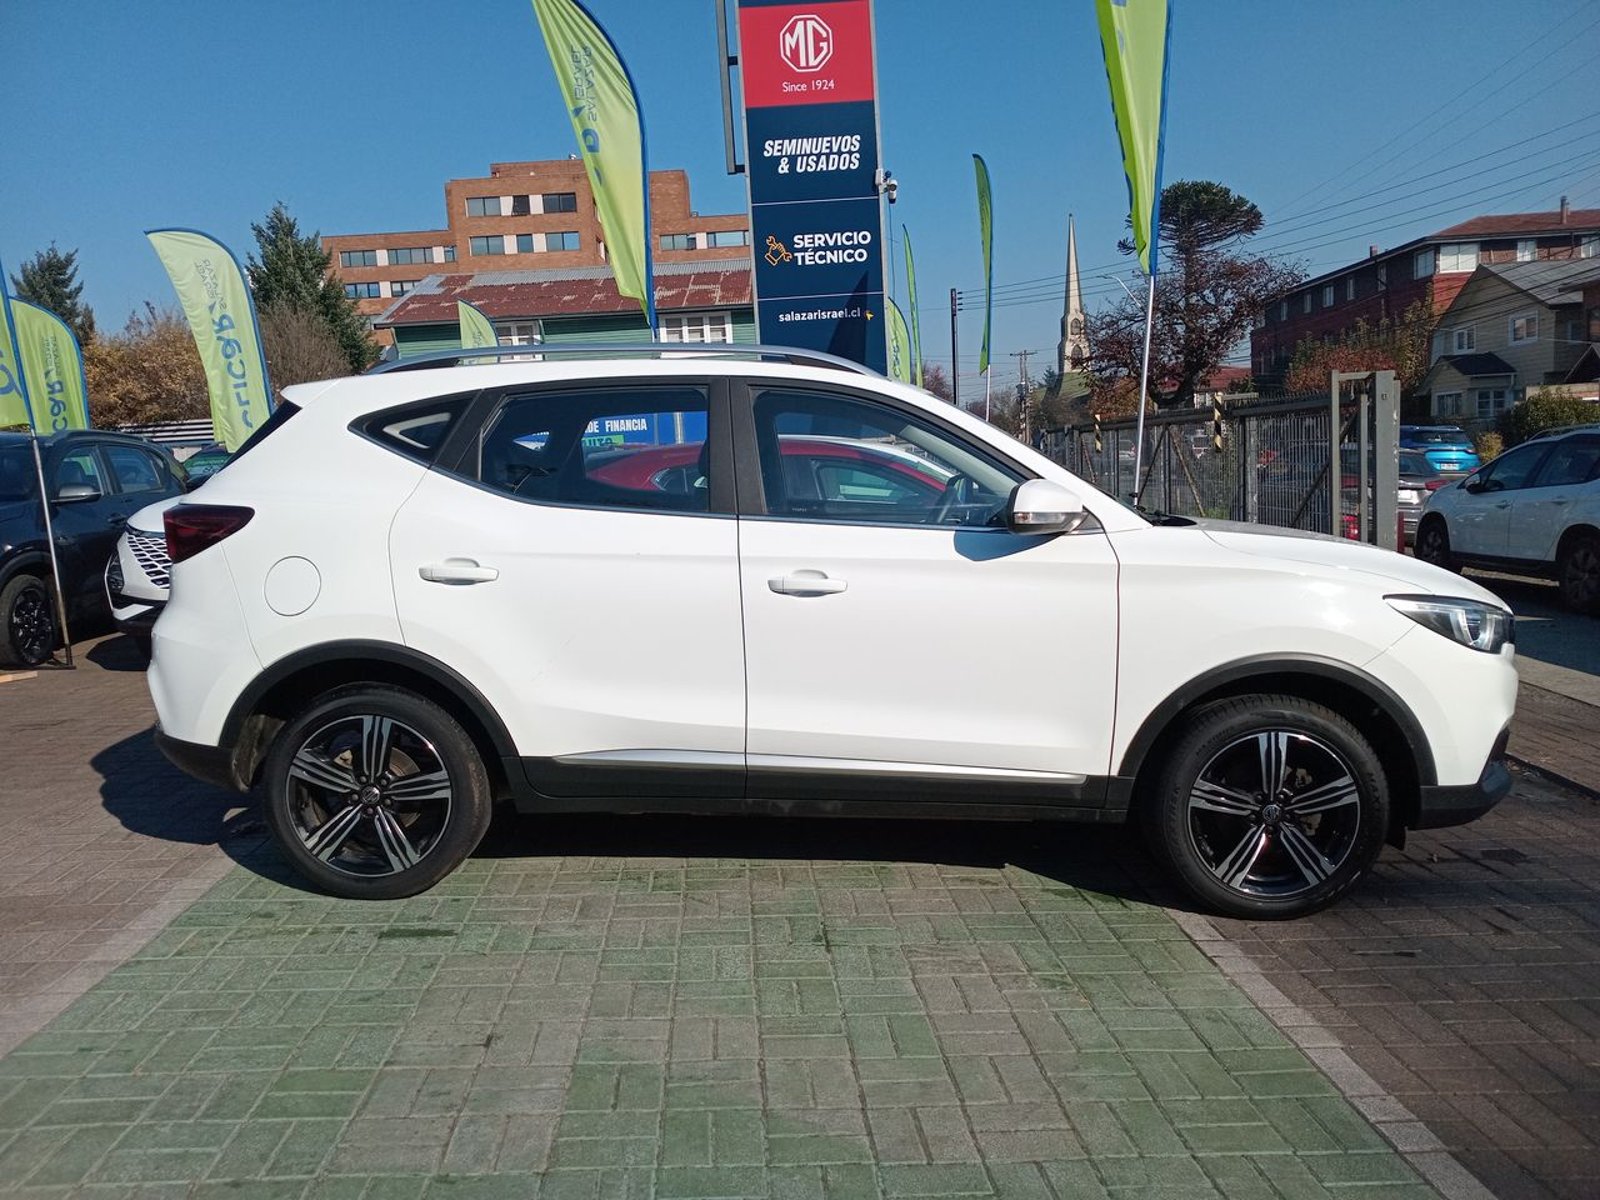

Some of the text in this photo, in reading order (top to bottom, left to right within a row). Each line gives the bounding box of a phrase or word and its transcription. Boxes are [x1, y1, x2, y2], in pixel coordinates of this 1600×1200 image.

[783, 19, 829, 68] MG
[782, 79, 835, 93] Since 1924
[763, 134, 861, 157] SEMINUEVOS
[778, 152, 860, 174] & USADOS
[793, 231, 871, 248] SERVICIO
[794, 248, 868, 266] TÉCNICO
[778, 307, 861, 322] salazarisrael.cl
[604, 418, 648, 432] FINANCIA
